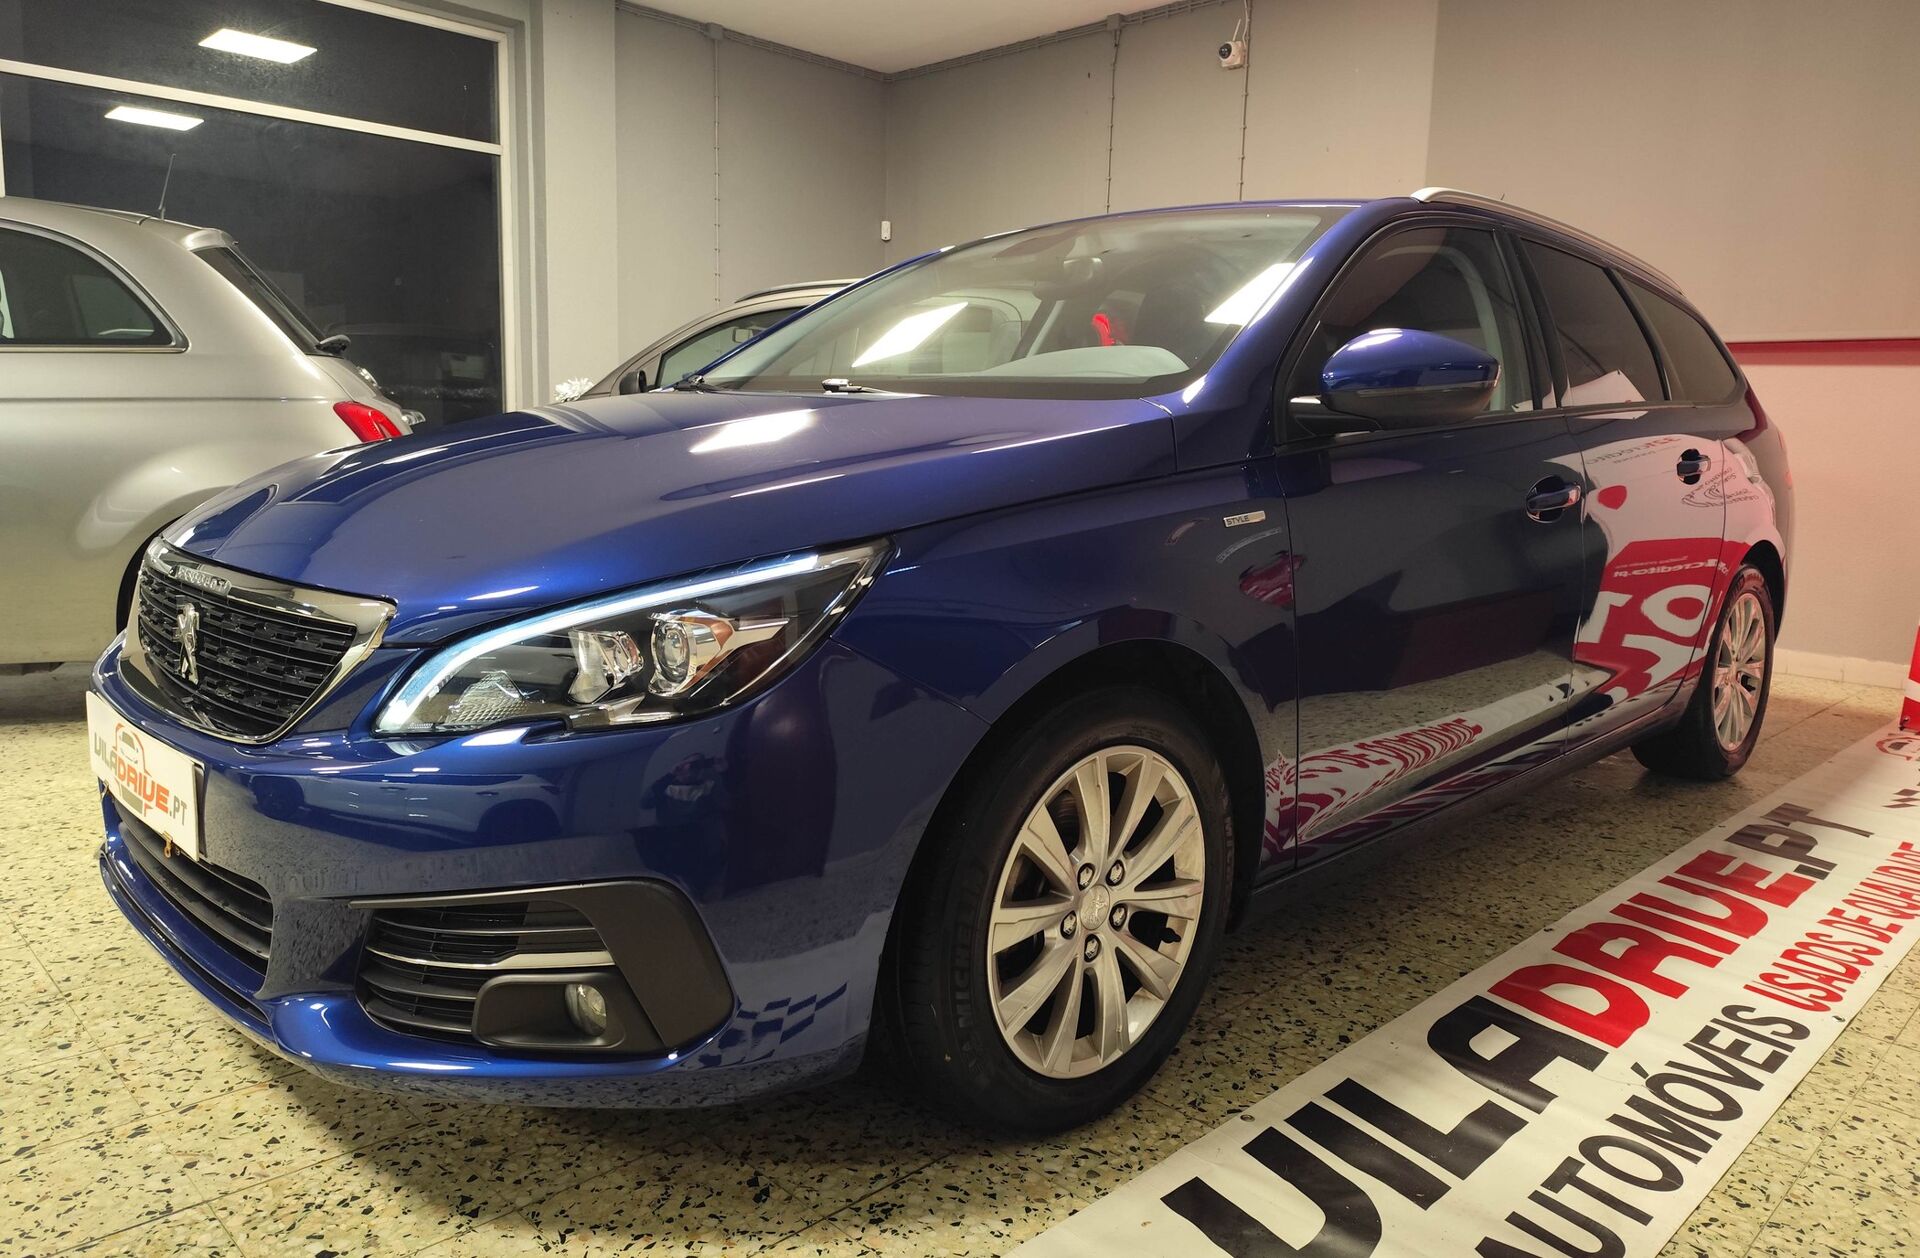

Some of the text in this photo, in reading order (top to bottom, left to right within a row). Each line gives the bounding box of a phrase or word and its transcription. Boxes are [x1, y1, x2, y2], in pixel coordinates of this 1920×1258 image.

[1226, 514, 1249, 526] STYLE
[1475, 1004, 1811, 1258] UTOMÓVEIS
[1743, 932, 1884, 1012] USADOS
[1817, 907, 1904, 944] DE
